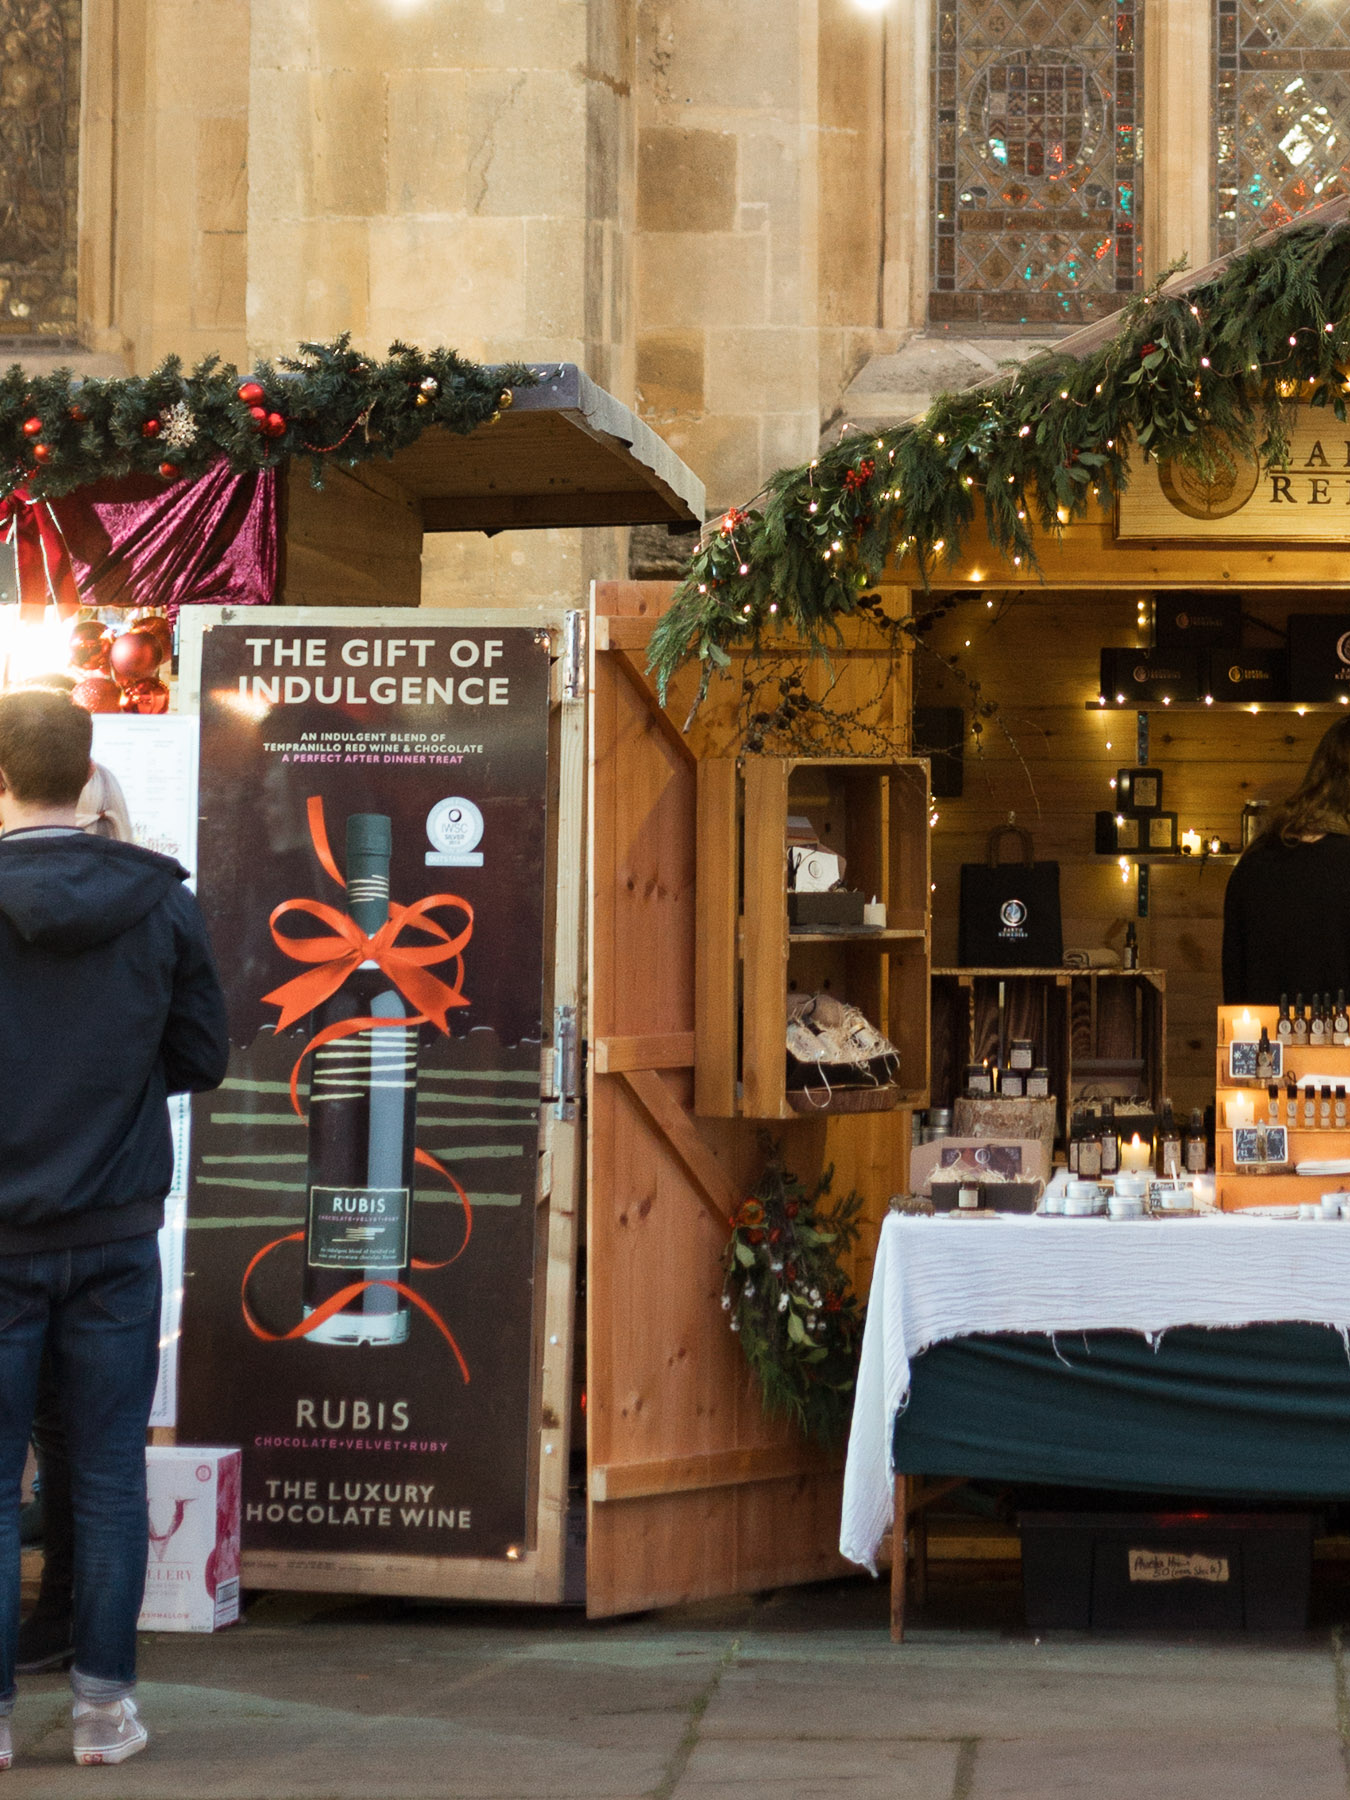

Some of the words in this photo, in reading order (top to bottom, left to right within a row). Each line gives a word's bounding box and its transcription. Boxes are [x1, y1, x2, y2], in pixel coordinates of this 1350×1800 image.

[245, 638, 327, 667] THE
[341, 638, 436, 668] GIFT
[449, 639, 504, 668] OF
[238, 675, 509, 705] INDULGENCE
[300, 732, 318, 742] AN
[320, 732, 387, 742] INDULGENT
[390, 733, 427, 742] BLEND
[431, 733, 446, 742] OF
[262, 742, 341, 752] TEMPRANILLO
[345, 742, 367, 752] RED
[369, 743, 400, 753] WINE
[403, 743, 411, 753] &
[414, 743, 484, 754] CHOCOLATE
[281, 753, 290, 763] A
[293, 753, 341, 763] PERFECT
[344, 754, 380, 764] AFTER
[383, 754, 426, 764] DINNER
[429, 754, 464, 765] TREAT
[441, 823, 469, 834] IWSC
[332, 1197, 386, 1213] RUBIS
[296, 1398, 410, 1432] RUBIS
[265, 1480, 318, 1499] THE
[328, 1482, 435, 1503] LUXURY
[245, 1503, 392, 1526] HOCOLATE
[400, 1507, 473, 1529] WINE
